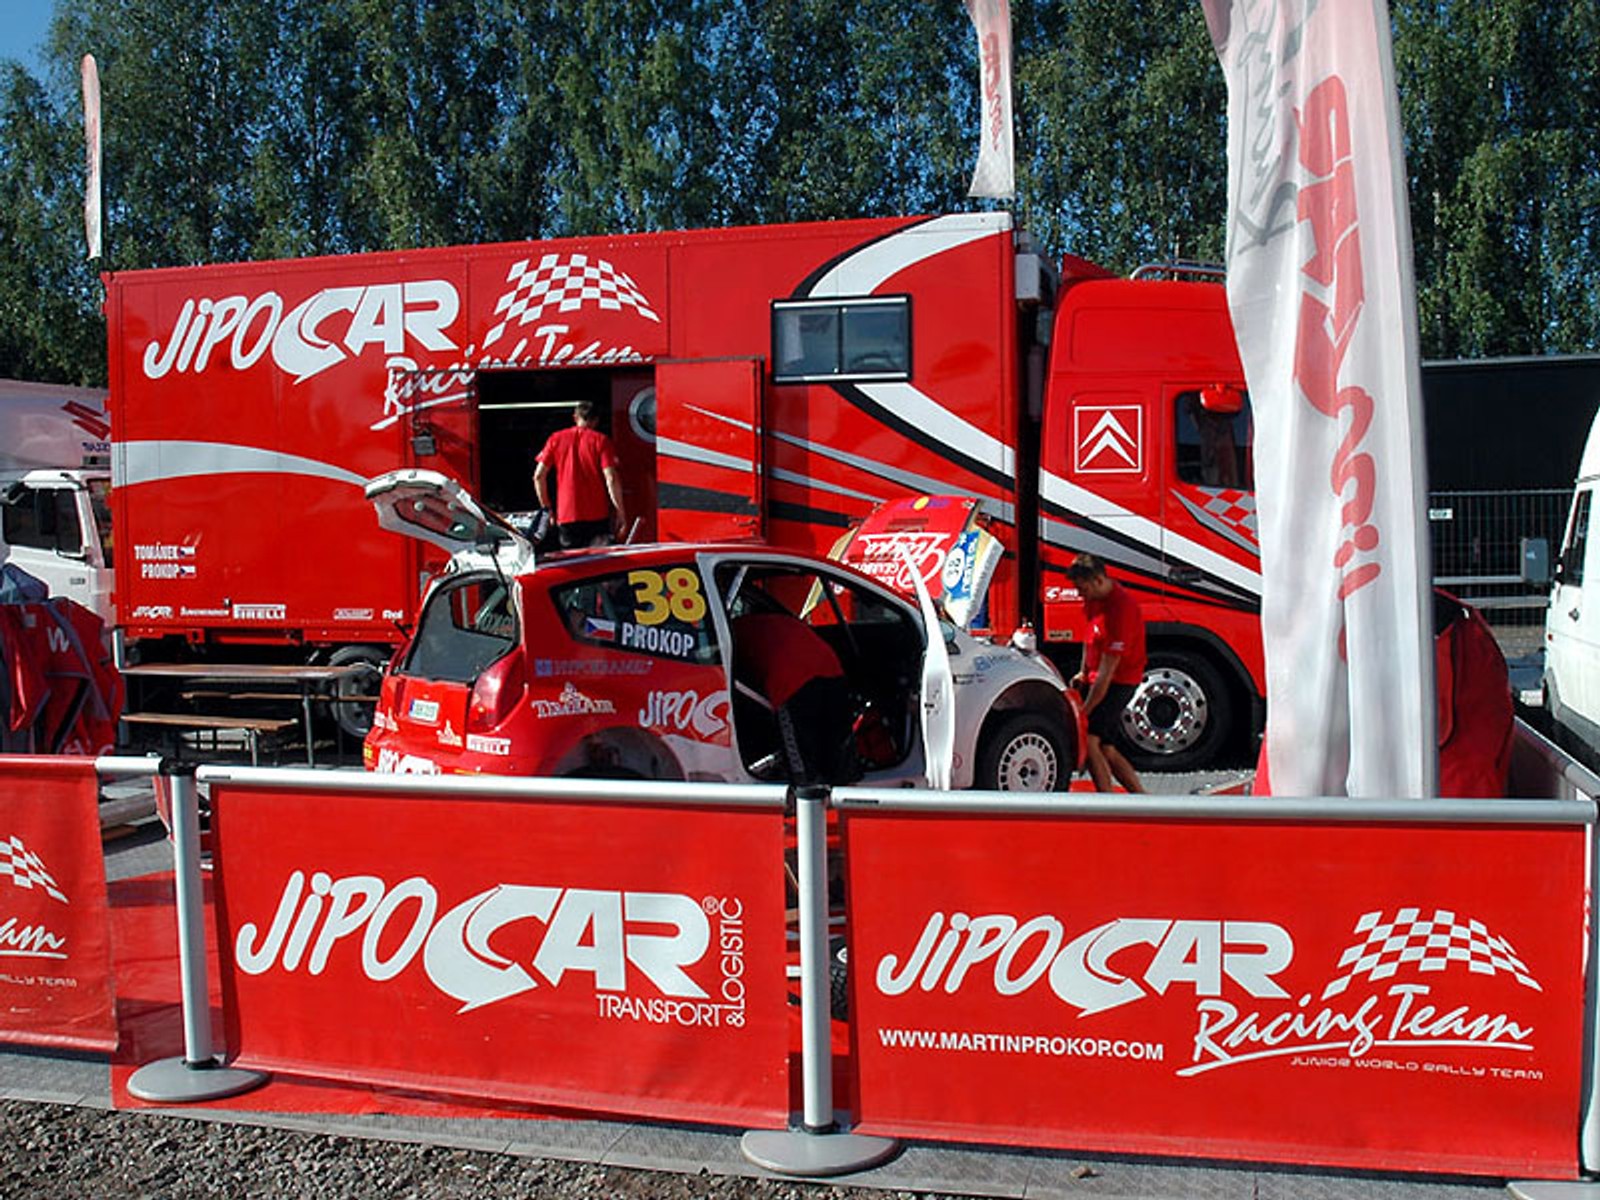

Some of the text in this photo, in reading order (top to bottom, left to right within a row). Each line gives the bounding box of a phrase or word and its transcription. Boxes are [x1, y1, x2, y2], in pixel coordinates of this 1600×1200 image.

[141, 563, 179, 579] PROKOP
[627, 567, 706, 626] 38
[621, 621, 695, 657] PROKOP
[596, 994, 723, 1028] TRANSPORT
[1192, 983, 1534, 1062] Racing Team
[878, 1028, 1165, 1060] WWW.MARTINPROKOP.COM
[1290, 1056, 1544, 1081] JUNIOR WORLD RALLY TEAM
